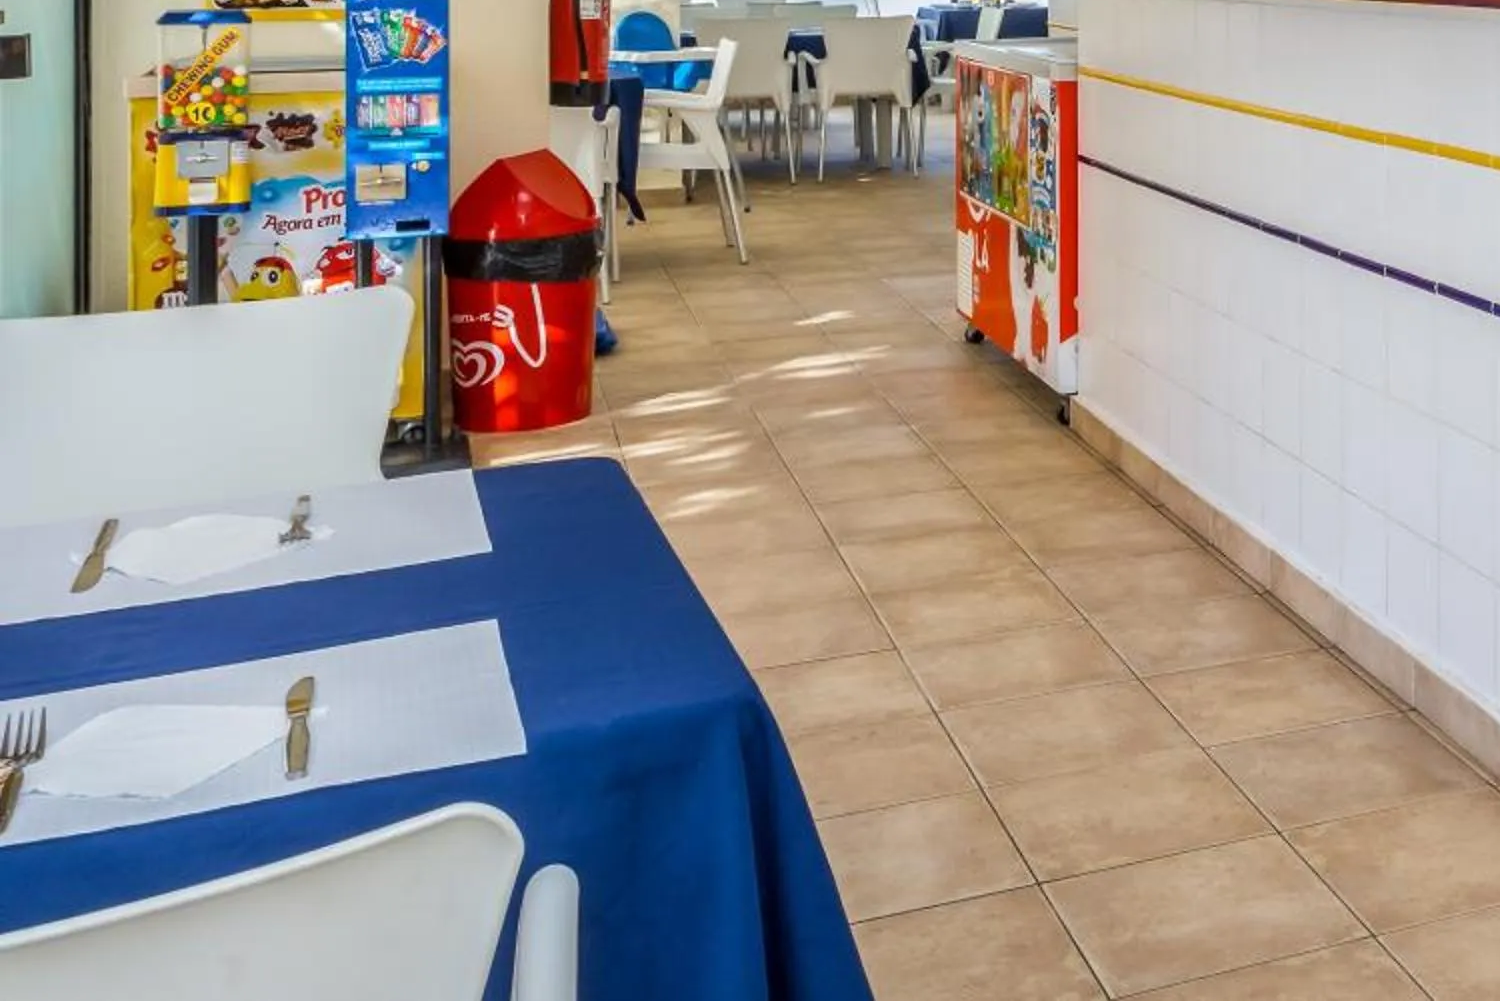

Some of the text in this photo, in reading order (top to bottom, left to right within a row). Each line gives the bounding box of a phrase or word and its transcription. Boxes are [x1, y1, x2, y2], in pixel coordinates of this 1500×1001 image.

[167, 30, 238, 103] CHEWING GUM
[192, 107, 212, 121] 1€
[262, 213, 341, 235] Agora em
